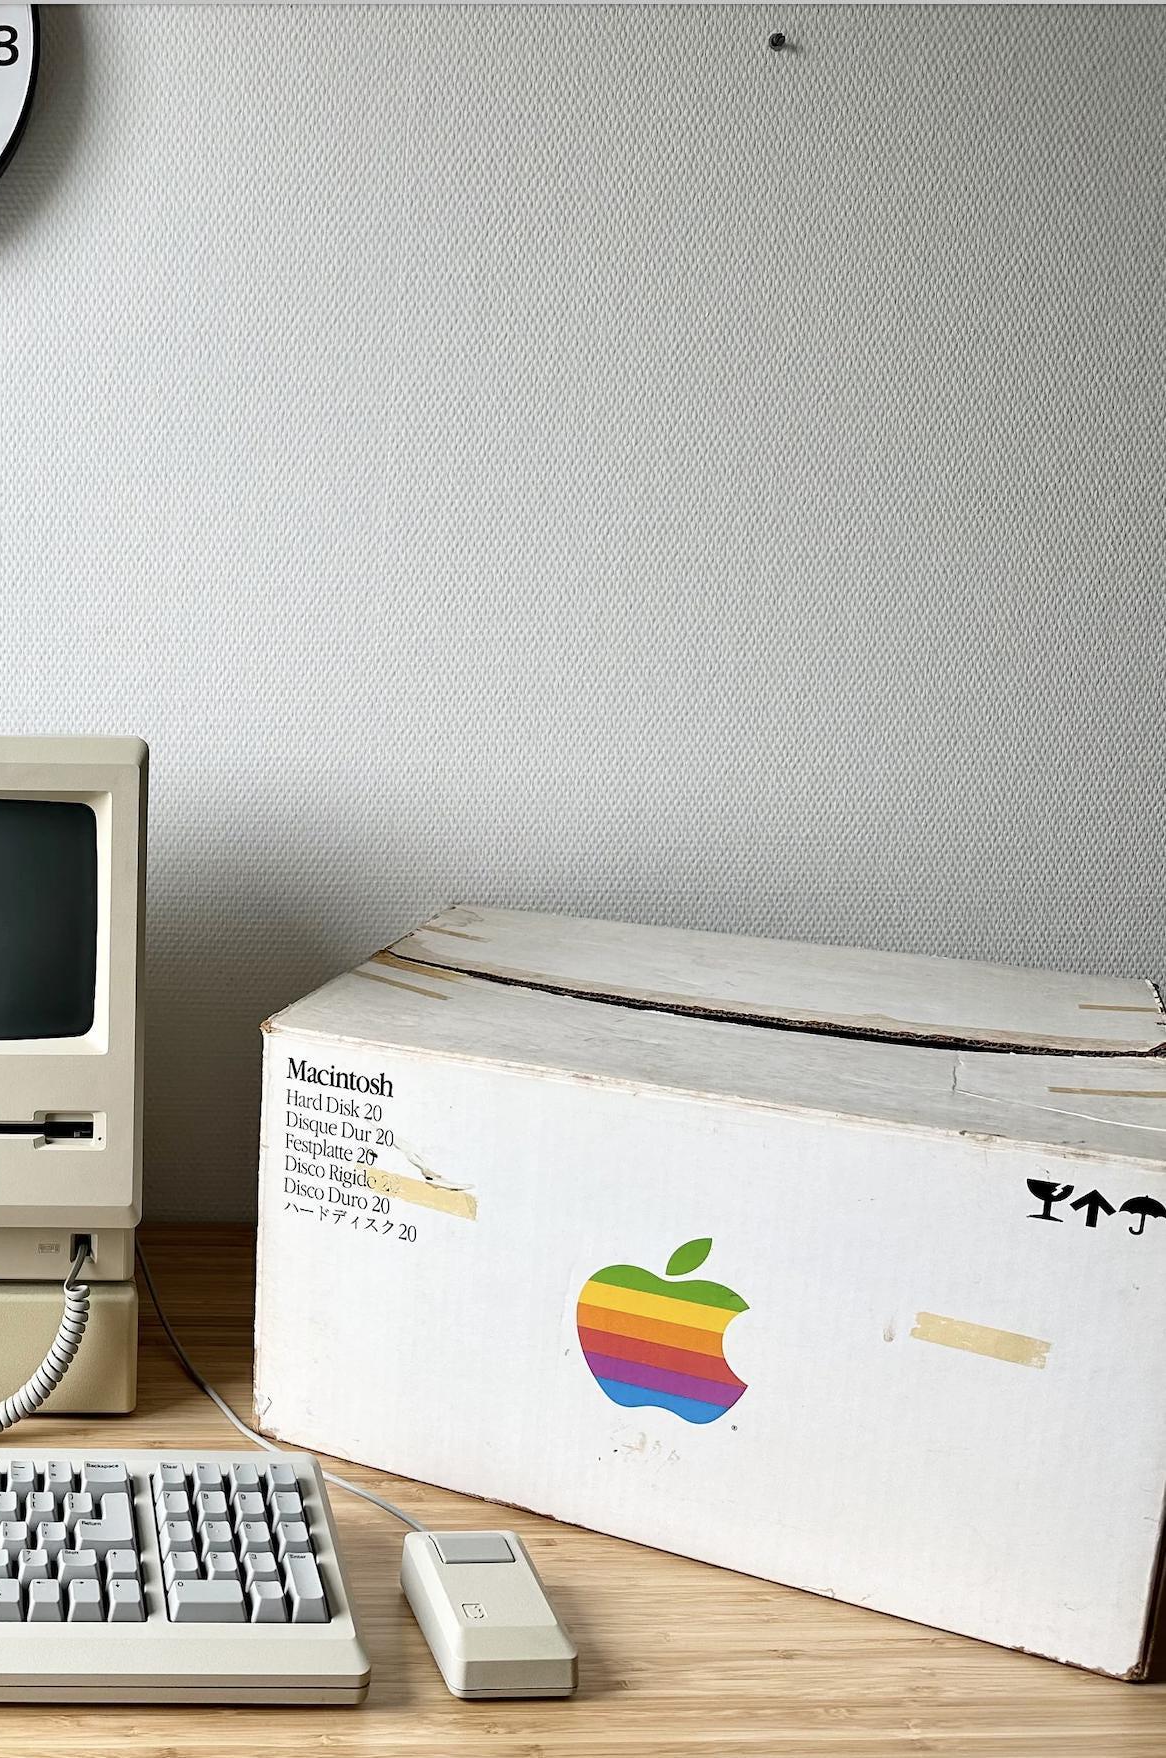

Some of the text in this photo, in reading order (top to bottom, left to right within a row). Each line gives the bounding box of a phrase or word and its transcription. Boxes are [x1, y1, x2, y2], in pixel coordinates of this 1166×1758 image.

[286, 1057, 394, 1098] Macintosh
[286, 1089, 382, 1122] Hard Disk 20
[285, 1111, 394, 1147] Disque Dur 20
[285, 1133, 375, 1166] Festplatte 20
[285, 1155, 325, 1178] Disco
[284, 1177, 390, 1215] Disco Duro 20
[284, 1202, 417, 1243] ハードディスク 20
